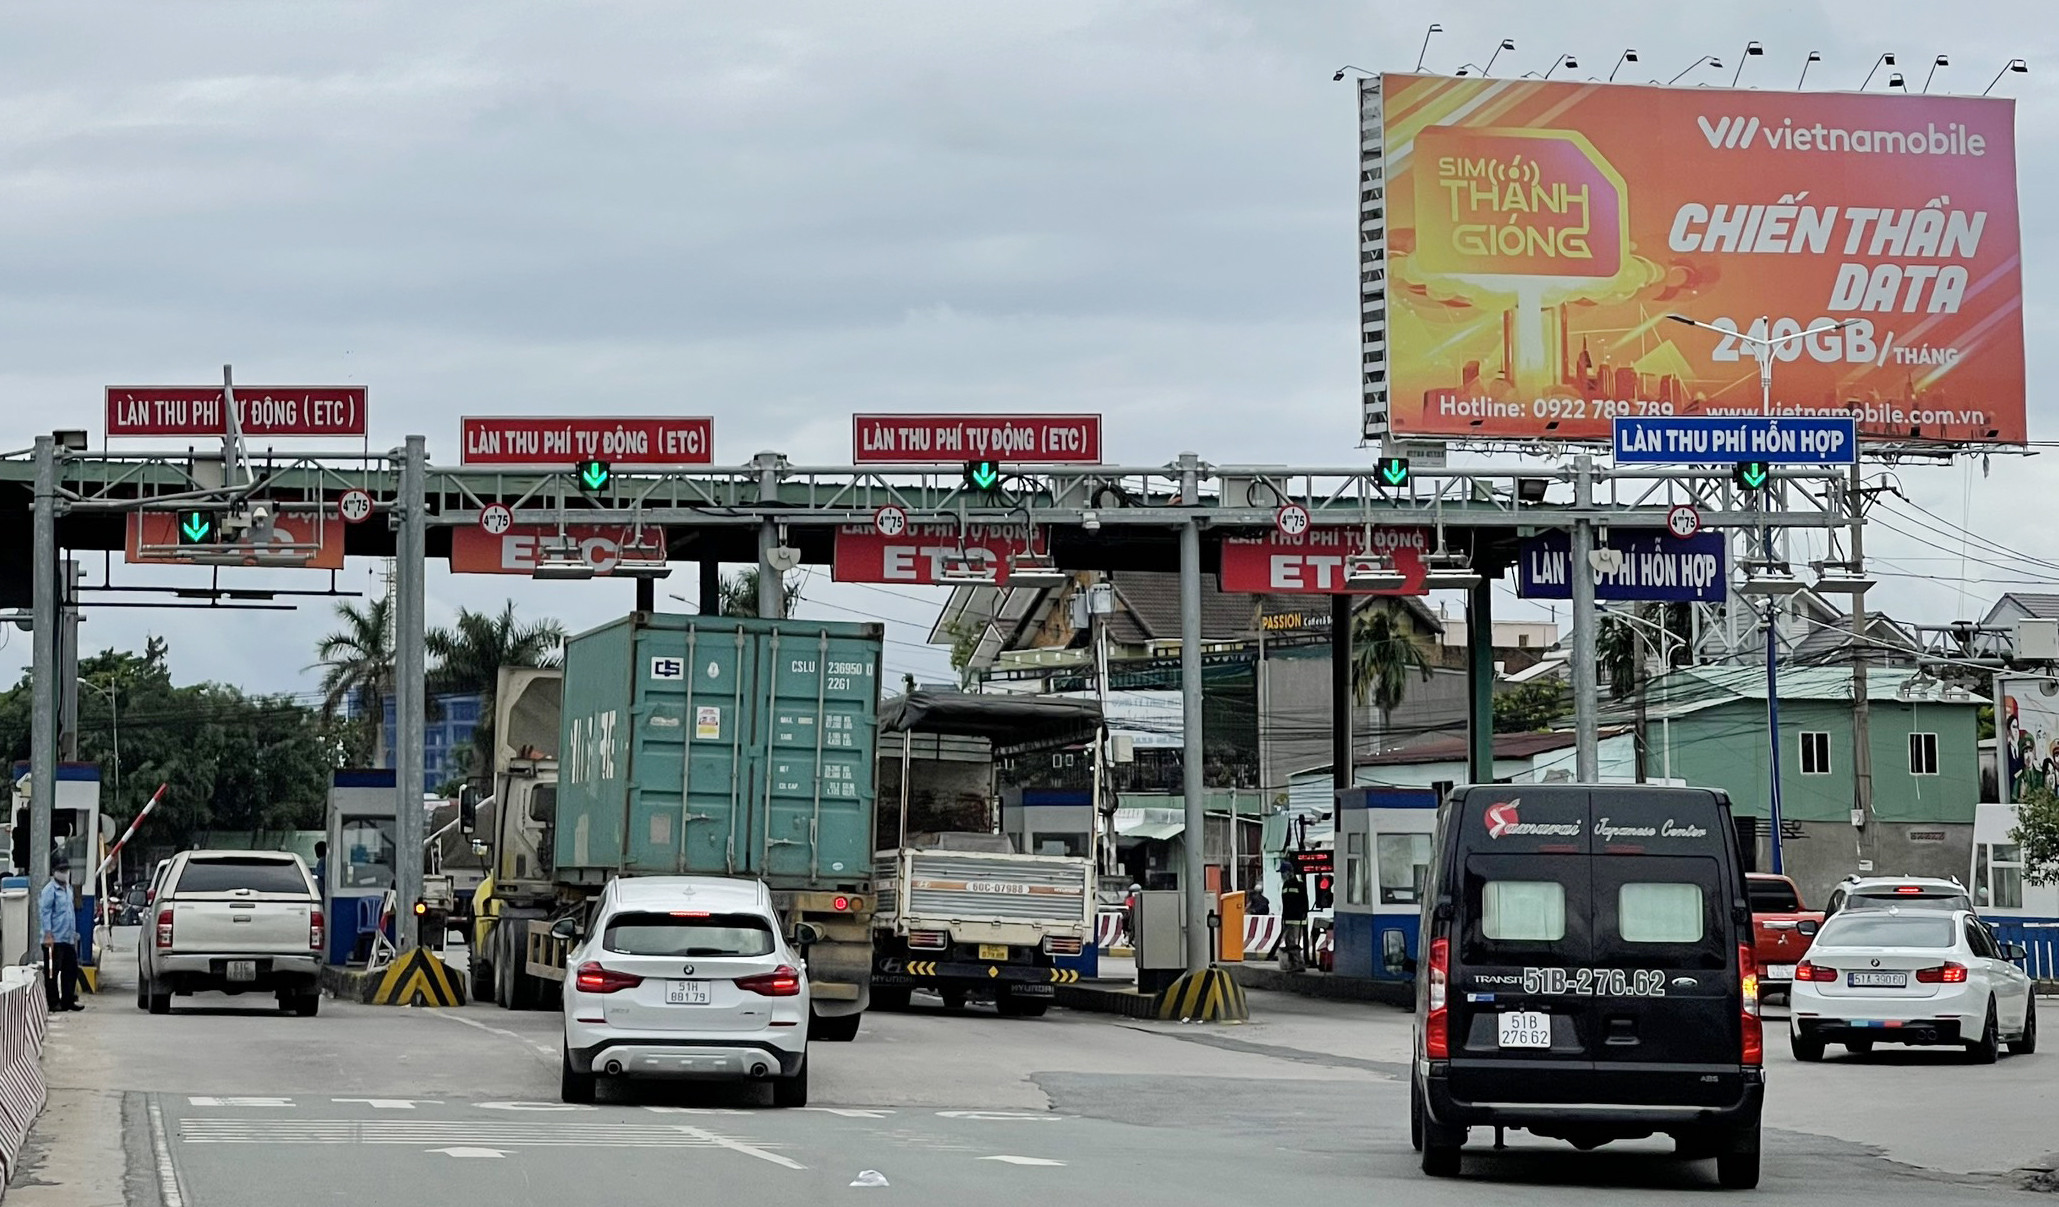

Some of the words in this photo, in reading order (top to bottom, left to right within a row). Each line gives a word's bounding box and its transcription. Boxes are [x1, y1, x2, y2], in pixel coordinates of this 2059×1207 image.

[1763, 118, 1986, 156] vietnamobile
[1439, 157, 1486, 177] SIM
[1452, 213, 1593, 259] GIÓNG
[1668, 191, 1839, 254] CHIẾN
[1843, 195, 1987, 258] THẦN
[1827, 263, 1968, 313] DATA
[117, 394, 149, 426] LÀN
[155, 400, 187, 426] THU
[193, 394, 221, 426] PHÍ
[252, 396, 297, 429] ĐỘNG
[1440, 396, 1526, 418] Hotline:
[1533, 400, 1586, 419] 0922
[1592, 400, 1629, 418] 789
[1638, 401, 1674, 416] 789
[468, 425, 500, 454] LÀN
[505, 431, 539, 454] THU
[544, 425, 571, 454] PHÍ
[576, 431, 600, 459] TỰ
[603, 424, 648, 459] ĐỘNG
[863, 422, 894, 450] LÀN
[899, 428, 930, 450] THU
[936, 422, 963, 450] PHÍ
[966, 428, 990, 456] TỰ
[992, 422, 1034, 456] ĐỘNG
[1622, 424, 1662, 453] LÀN
[1666, 429, 1707, 452] THU
[1713, 425, 1747, 452] PHÍ
[1752, 420, 1796, 453] HỖN
[1801, 429, 1845, 458] HỢP
[1532, 542, 1564, 584] LÀN
[1641, 537, 1677, 587] HỖN
[1681, 553, 1717, 597] HỢP
[1262, 612, 1301, 629] PASSION
[791, 660, 815, 673] CSLU
[827, 661, 863, 675] 236950
[1489, 798, 1583, 840] Samurai
[1594, 818, 1656, 841] Japanese
[1661, 818, 1707, 838] Center
[679, 982, 698, 991] 51H
[1474, 975, 1523, 985] TRANSIT
[1511, 1015, 1538, 1029] 51B
